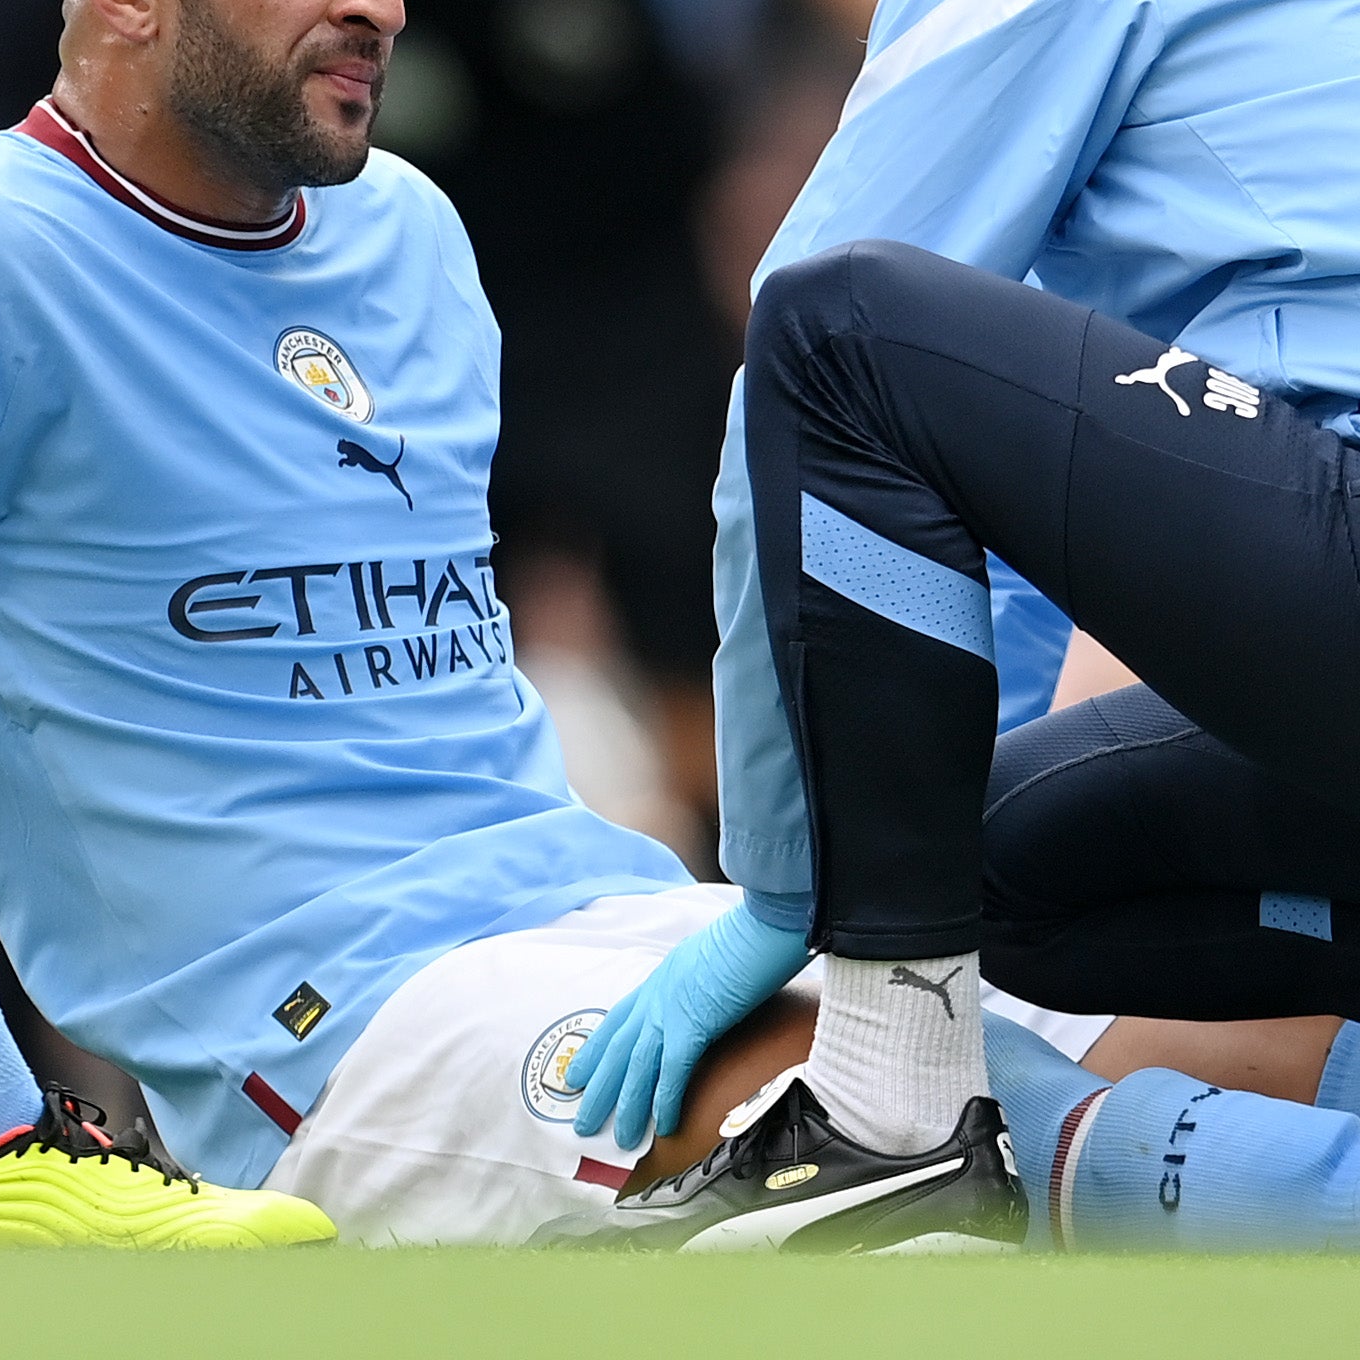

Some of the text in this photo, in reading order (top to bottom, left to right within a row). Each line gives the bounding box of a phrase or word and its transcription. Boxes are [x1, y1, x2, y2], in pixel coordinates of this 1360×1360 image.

[281, 335, 342, 371] MANCHESTER
[290, 621, 507, 700] AIRWAYS
[530, 1018, 583, 1103] MANCHESTER
[777, 1167, 807, 1187] KING
[1159, 1087, 1222, 1213] CITY
